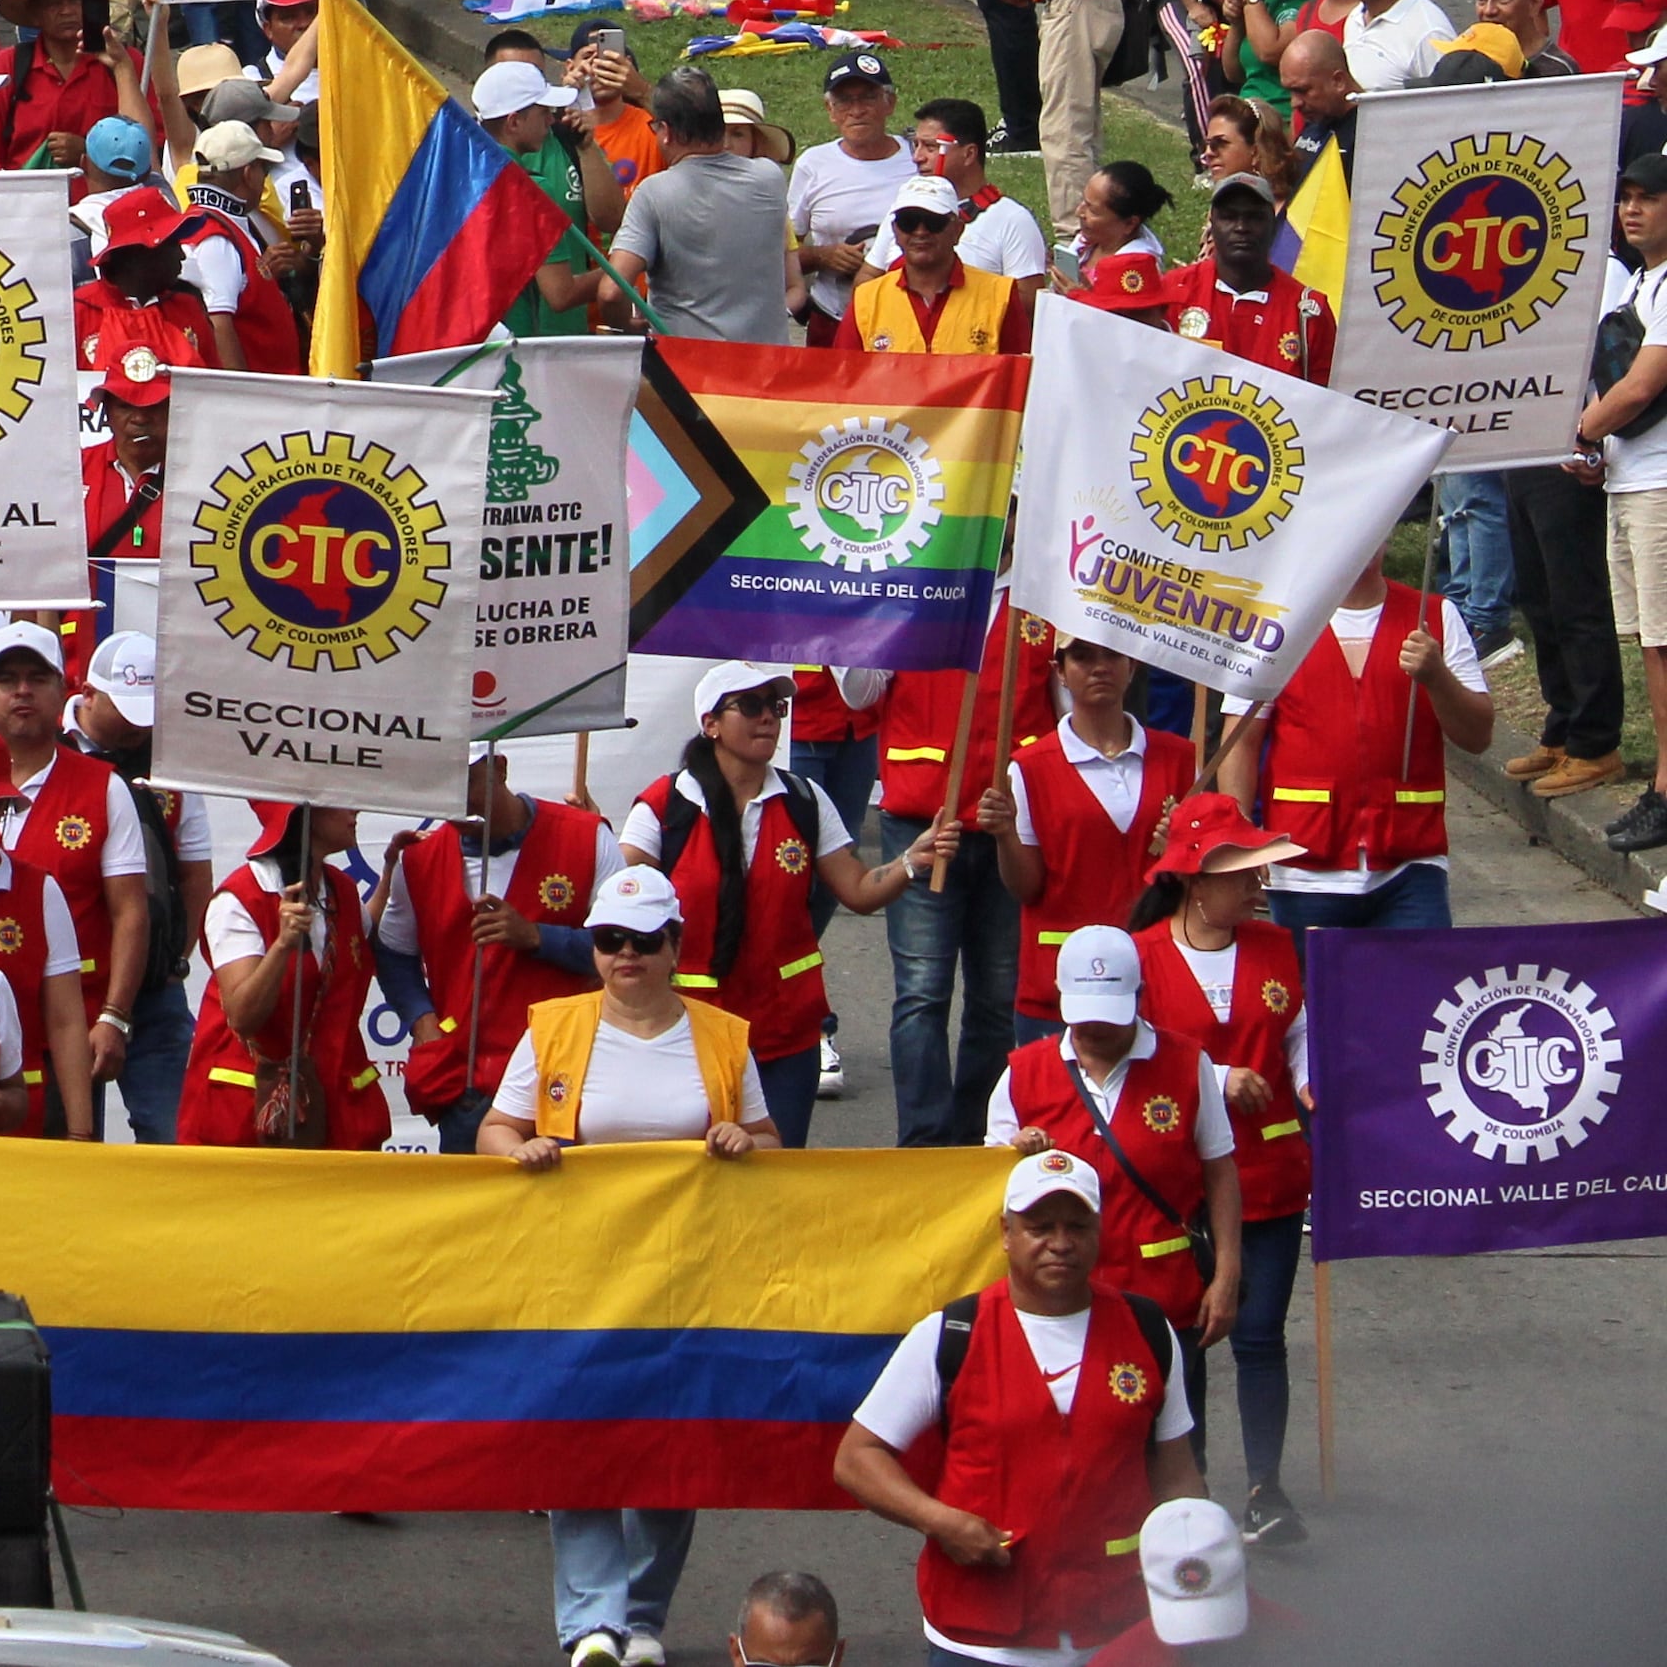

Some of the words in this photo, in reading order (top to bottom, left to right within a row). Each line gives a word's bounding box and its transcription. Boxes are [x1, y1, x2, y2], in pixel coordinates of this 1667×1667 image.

[1422, 215, 1540, 272] CTC
[1170, 433, 1265, 496] CTC
[819, 472, 909, 514] CTC
[248, 523, 392, 588] CTC
[1100, 539, 1174, 578] COMITÉ
[1177, 566, 1205, 590] DE
[730, 574, 825, 594] SECCIONAL
[829, 580, 882, 597] VALLE
[886, 584, 919, 599] DEL
[922, 585, 966, 600] CAUCA
[1078, 555, 1285, 654] JUVENTUD
[183, 690, 442, 743] SECCIONAL
[236, 730, 384, 770] VALLE
[1465, 1036, 1577, 1089] CTC
[1359, 1187, 1494, 1209] SECCIONAL
[1499, 1181, 1569, 1203] VALLE
[1575, 1177, 1617, 1197] DEL
